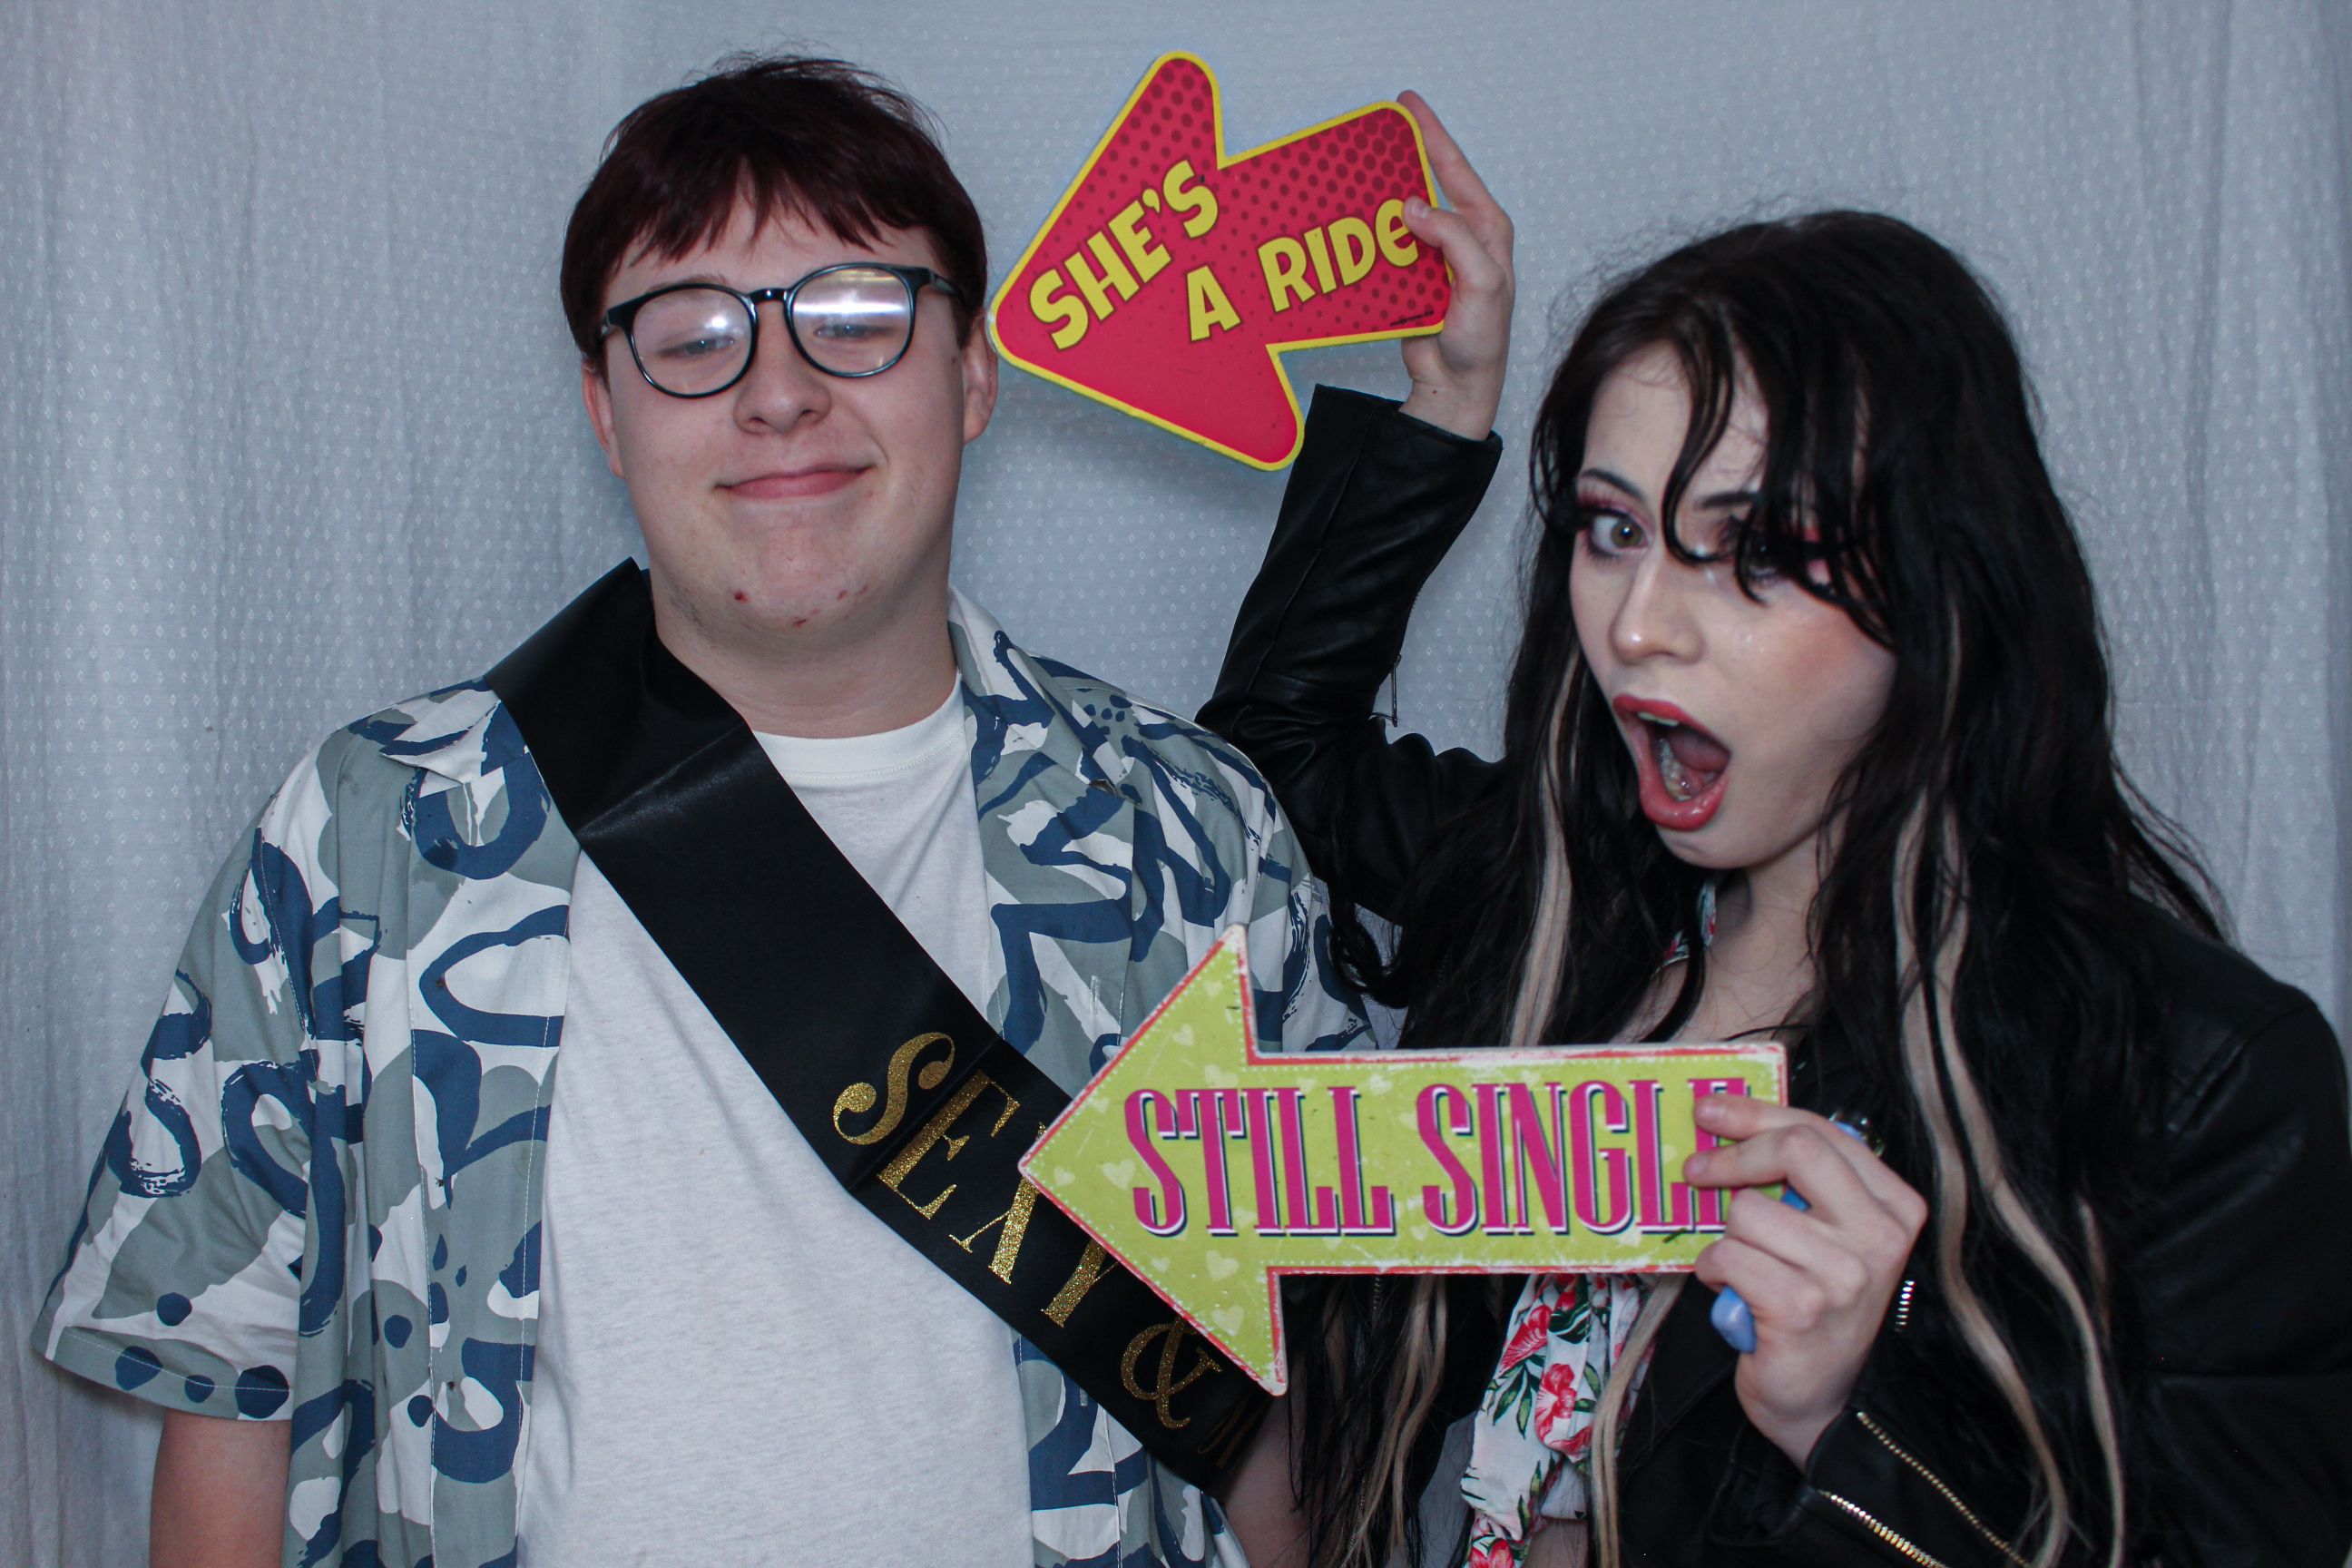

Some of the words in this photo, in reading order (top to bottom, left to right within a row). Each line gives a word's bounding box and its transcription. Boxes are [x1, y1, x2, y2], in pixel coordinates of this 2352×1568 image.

[1029, 160, 1219, 350] SHE'S
[1187, 265, 1241, 341] A
[1124, 1086, 1396, 1237] STILL
[1121, 1315, 1222, 1429] &
